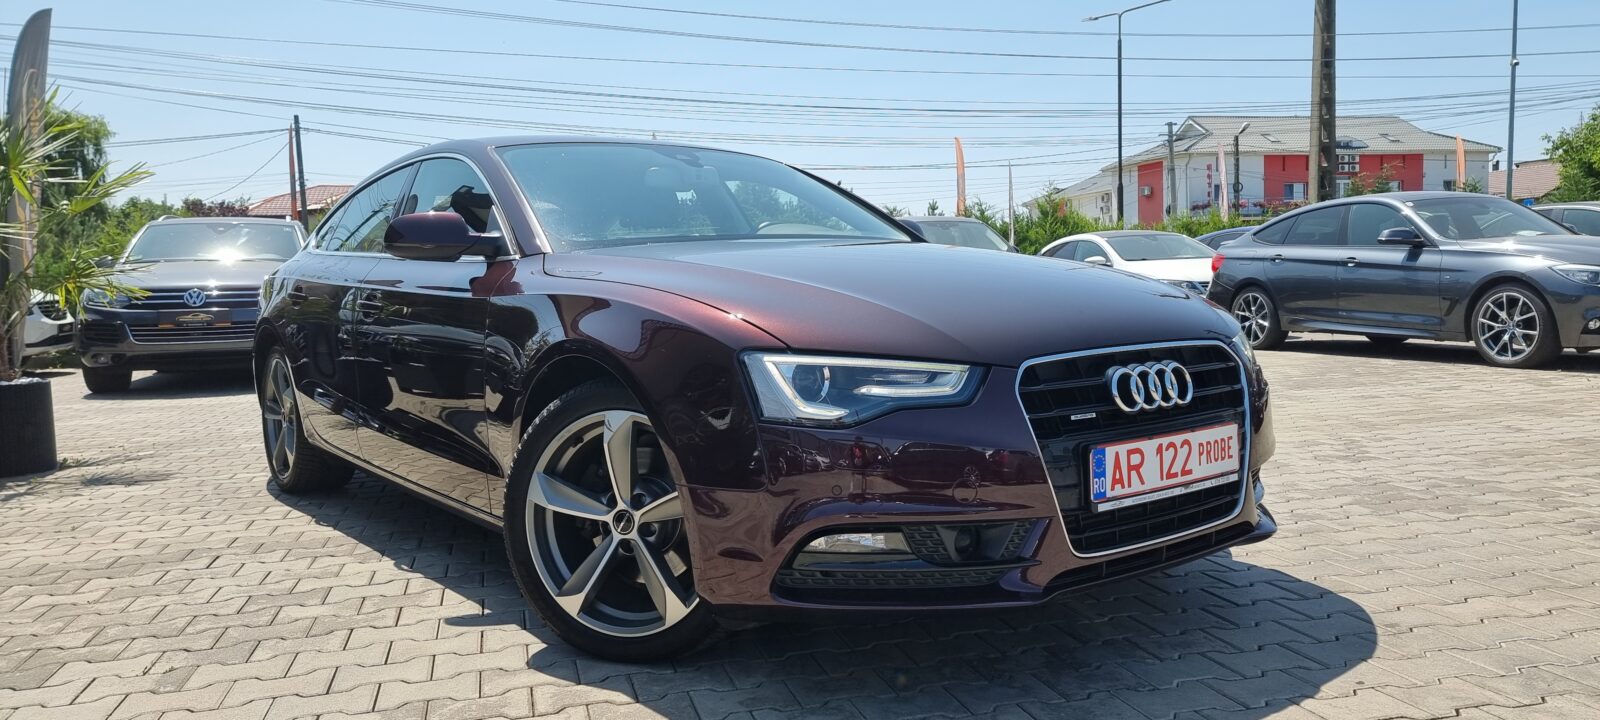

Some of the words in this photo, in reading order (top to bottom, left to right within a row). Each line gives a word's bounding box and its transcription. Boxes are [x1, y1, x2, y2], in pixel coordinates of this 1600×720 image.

[1111, 448, 1145, 491] AR
[1156, 439, 1193, 481] 122
[1198, 436, 1233, 466] PROBE
[1094, 477, 1106, 493] RO
